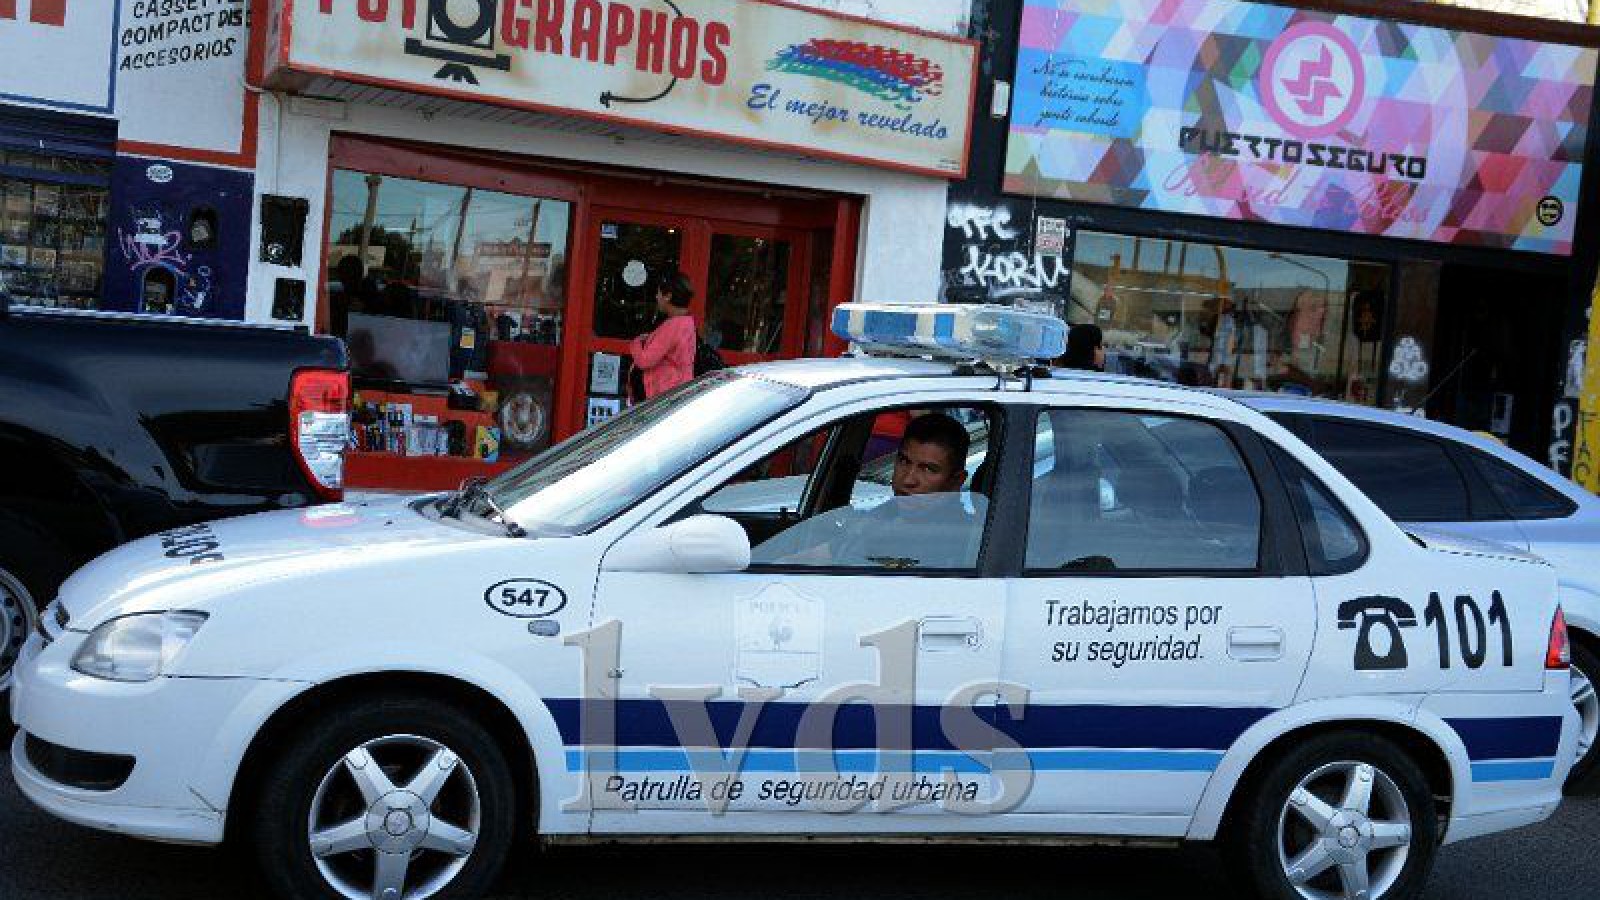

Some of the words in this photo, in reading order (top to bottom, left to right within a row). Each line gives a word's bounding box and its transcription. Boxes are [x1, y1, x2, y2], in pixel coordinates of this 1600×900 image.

[121, 11, 214, 47] COMPACT
[119, 37, 237, 70] ACCESORIOS
[747, 83, 781, 110] El
[786, 99, 850, 125] mejor
[857, 112, 948, 139] revelado
[501, 588, 551, 609] 547
[1045, 600, 1178, 632] Trabajamos
[1185, 605, 1223, 631] por
[1423, 590, 1514, 669] 101
[1051, 641, 1081, 662] su
[1087, 633, 1205, 668] seguridad.
[604, 775, 702, 801] Patrulla
[711, 775, 745, 801] de
[758, 774, 885, 806] seguridad
[892, 775, 979, 801] urbana
